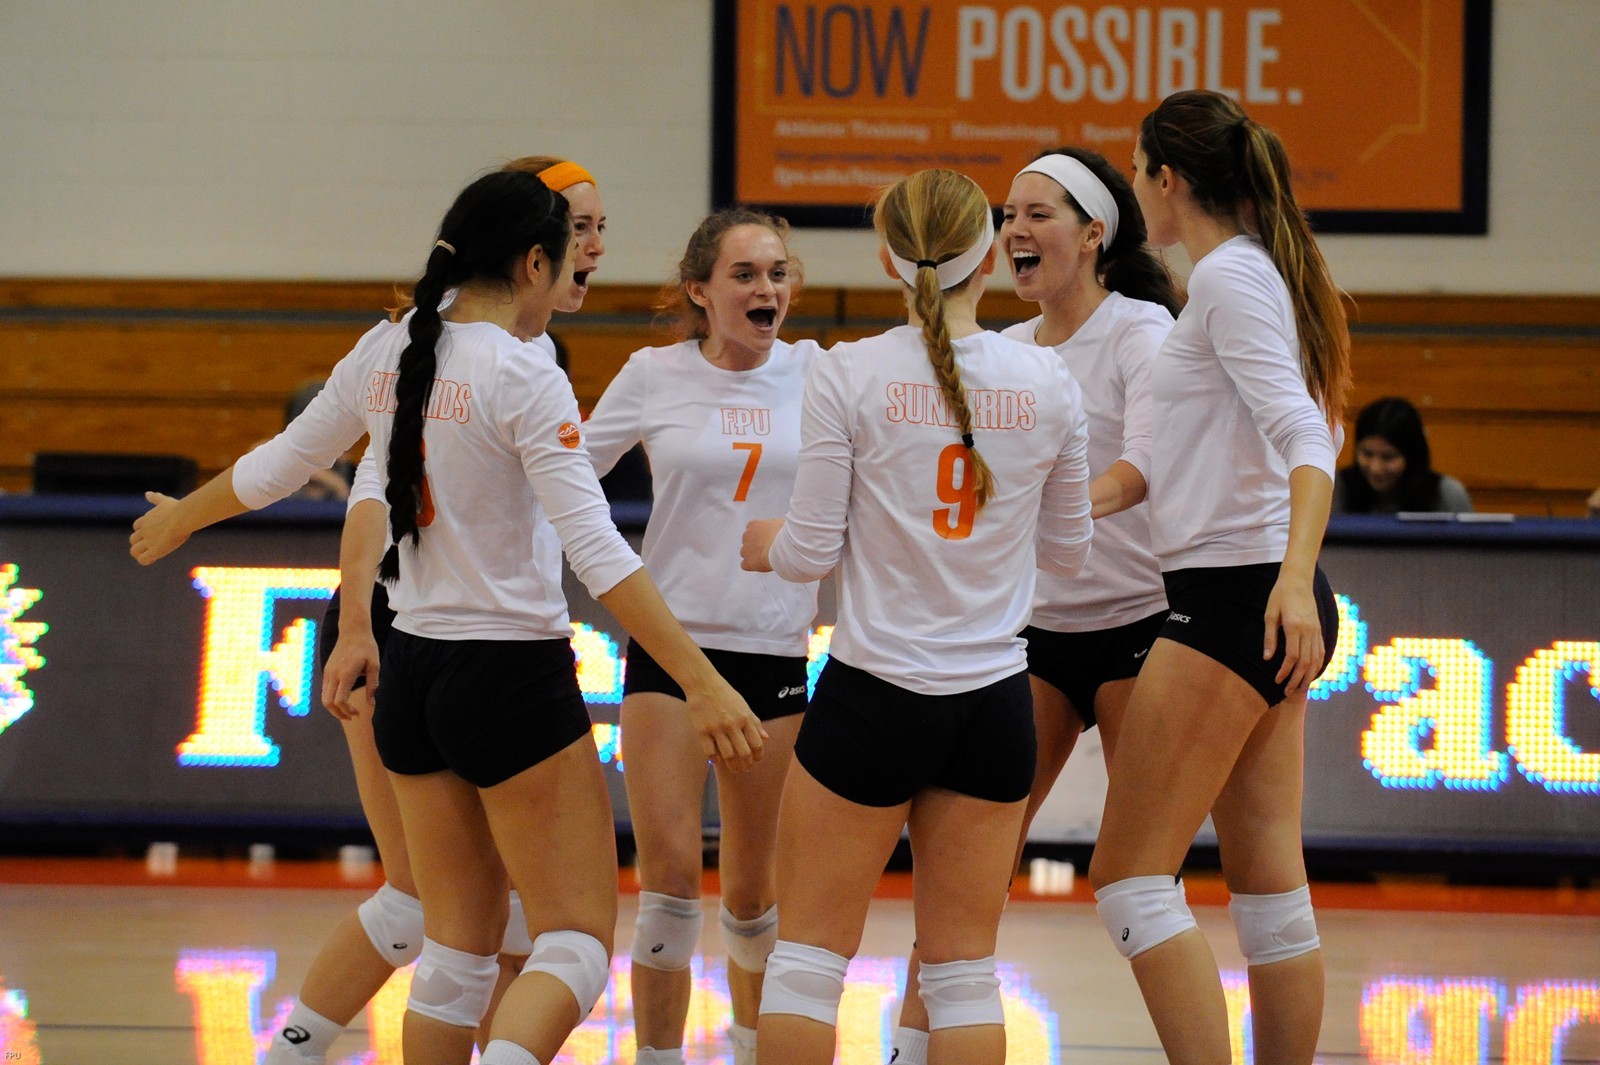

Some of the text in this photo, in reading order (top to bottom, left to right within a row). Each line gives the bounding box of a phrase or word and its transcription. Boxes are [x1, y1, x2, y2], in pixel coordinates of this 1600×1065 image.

[774, 3, 1304, 105] NOW POSSIBLE.
[720, 407, 771, 436] FPU
[732, 442, 763, 502] 7
[932, 443, 978, 541] 9
